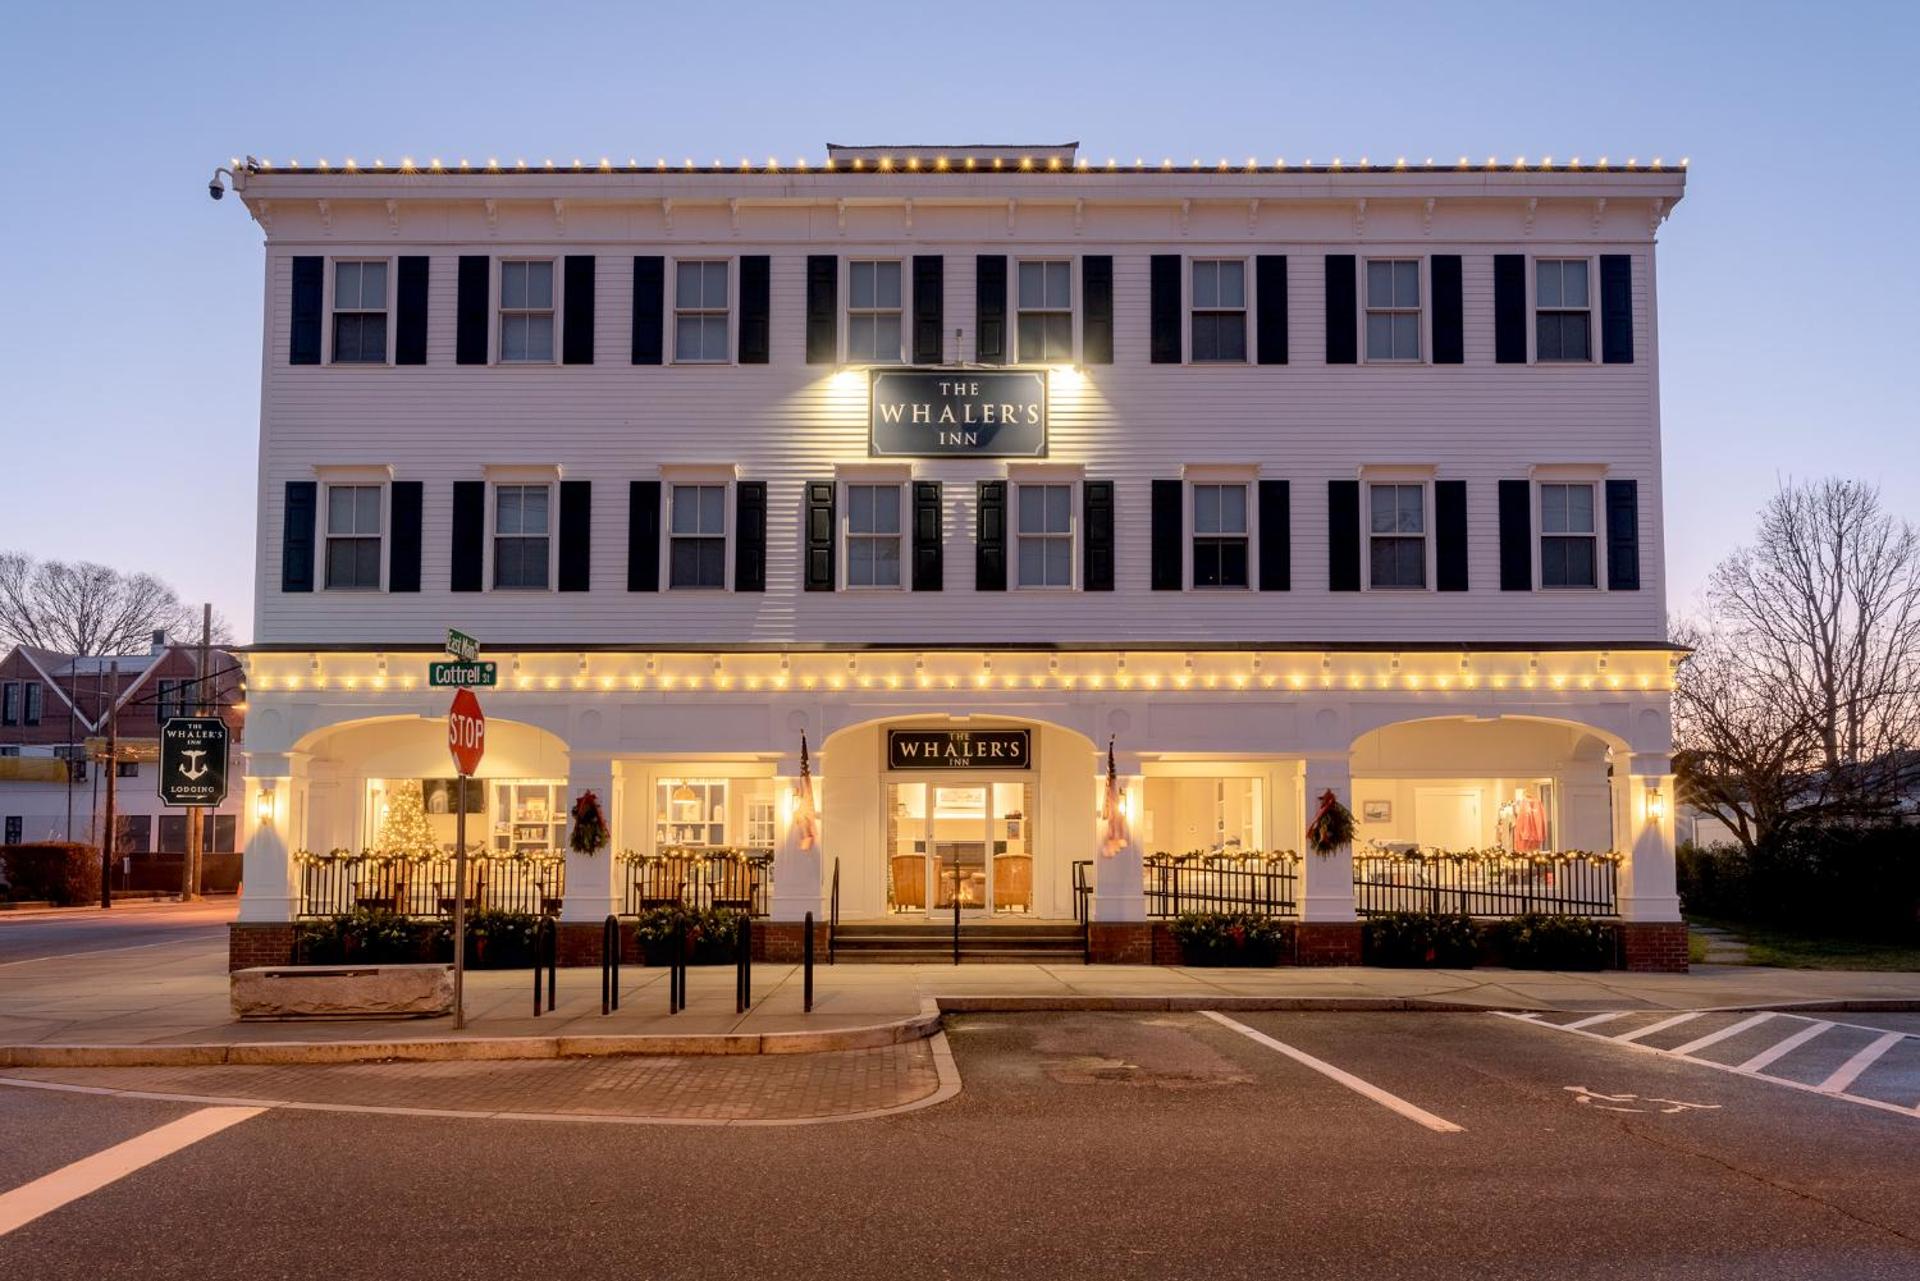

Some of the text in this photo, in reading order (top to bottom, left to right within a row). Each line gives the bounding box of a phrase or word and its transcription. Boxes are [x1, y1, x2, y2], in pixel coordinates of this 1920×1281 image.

[939, 382, 979, 395] THE
[880, 404, 1039, 424] WHALER'S
[939, 432, 977, 445] INN
[435, 664, 480, 684] Cottrell
[167, 730, 223, 738] WHALER'S
[450, 712, 484, 749] STOP
[949, 733, 970, 741] THE
[899, 742, 1020, 757] WHALER'S
[949, 758, 970, 766] INN
